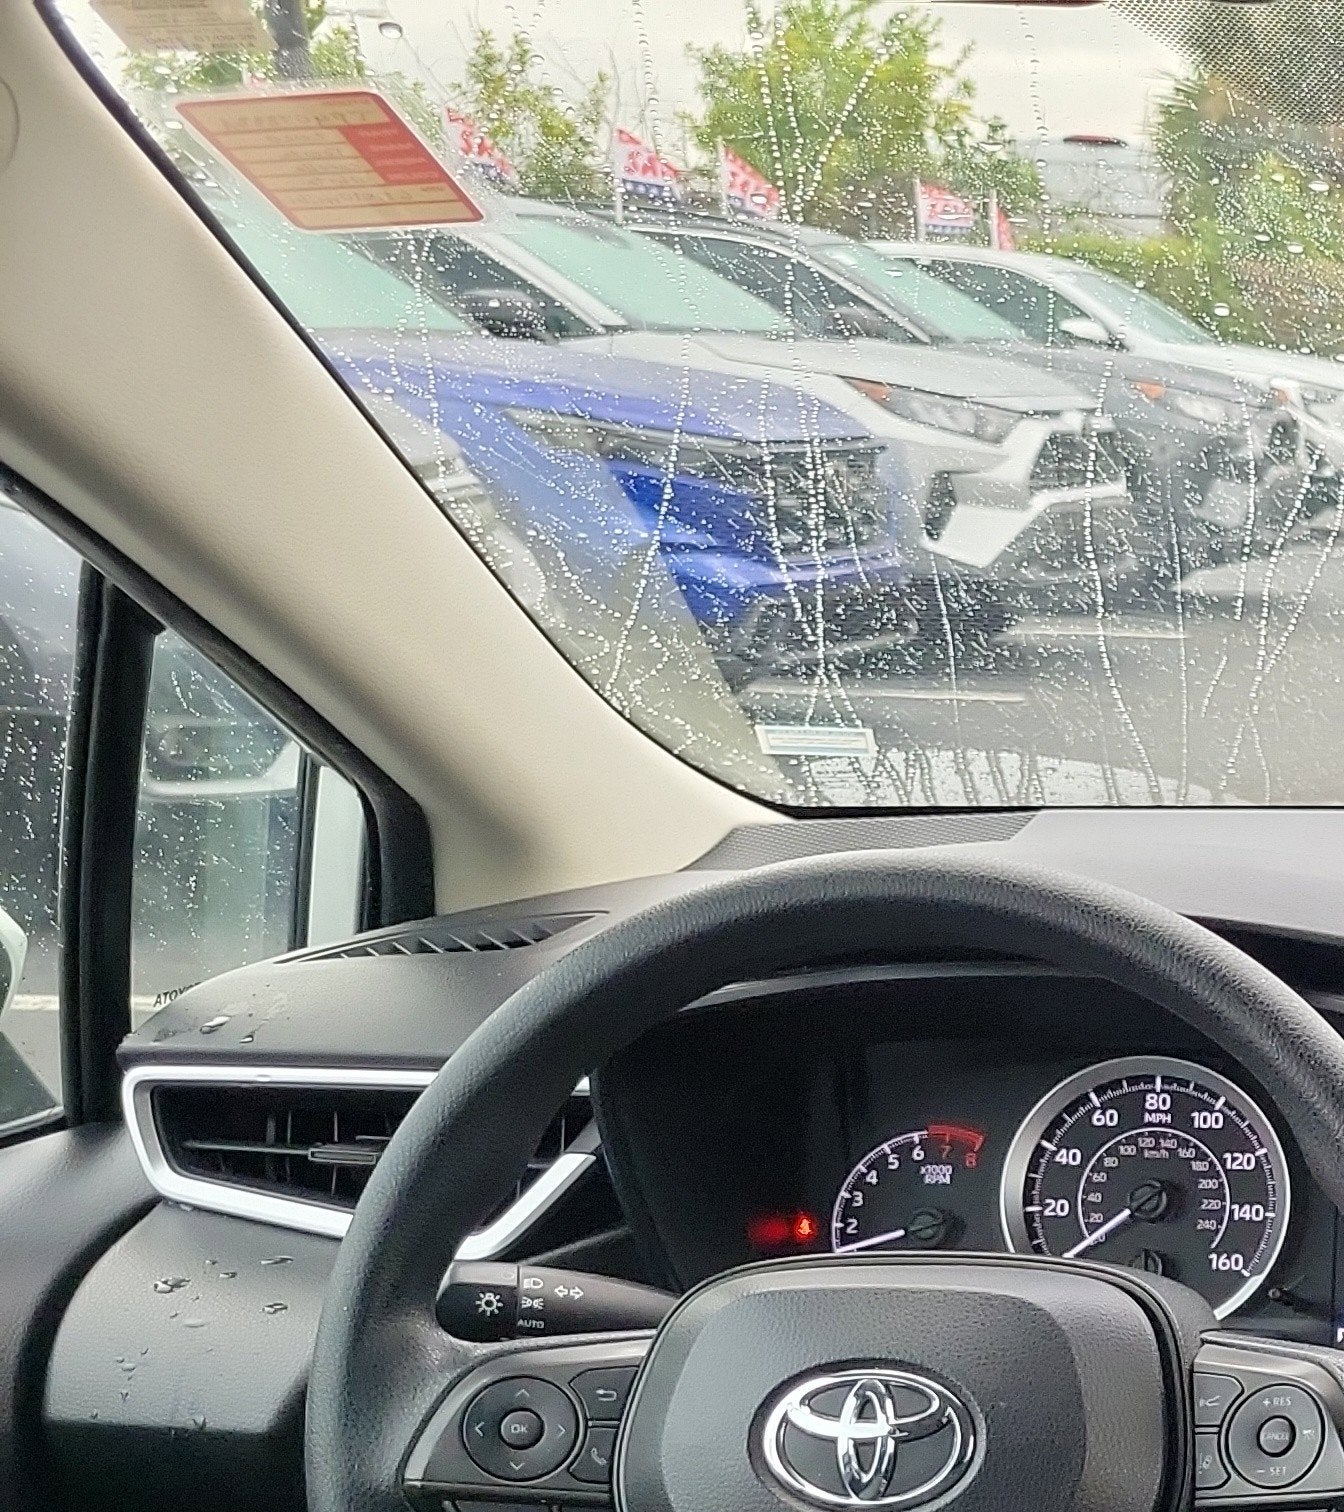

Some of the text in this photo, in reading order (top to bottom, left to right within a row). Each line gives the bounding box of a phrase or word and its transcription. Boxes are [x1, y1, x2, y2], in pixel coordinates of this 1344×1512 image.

[1145, 1093, 1171, 1111] 80
[1091, 1110, 1119, 1127] 60
[1144, 1113, 1172, 1124] MPH
[1191, 1112, 1223, 1129] 100
[912, 1145, 924, 1160] 6
[941, 1145, 951, 1160] 7
[1055, 1149, 1081, 1166] 40
[888, 1154, 899, 1170] 5
[1222, 1152, 1256, 1171] 120
[866, 1170, 878, 1185] 4
[852, 1191, 863, 1207] 3
[1043, 1199, 1069, 1217] 20
[1231, 1205, 1264, 1222] 140
[846, 1218, 858, 1234] 2
[1208, 1253, 1244, 1271] 160
[517, 1318, 545, 1329] AUTO
[511, 1424, 528, 1434] OK
